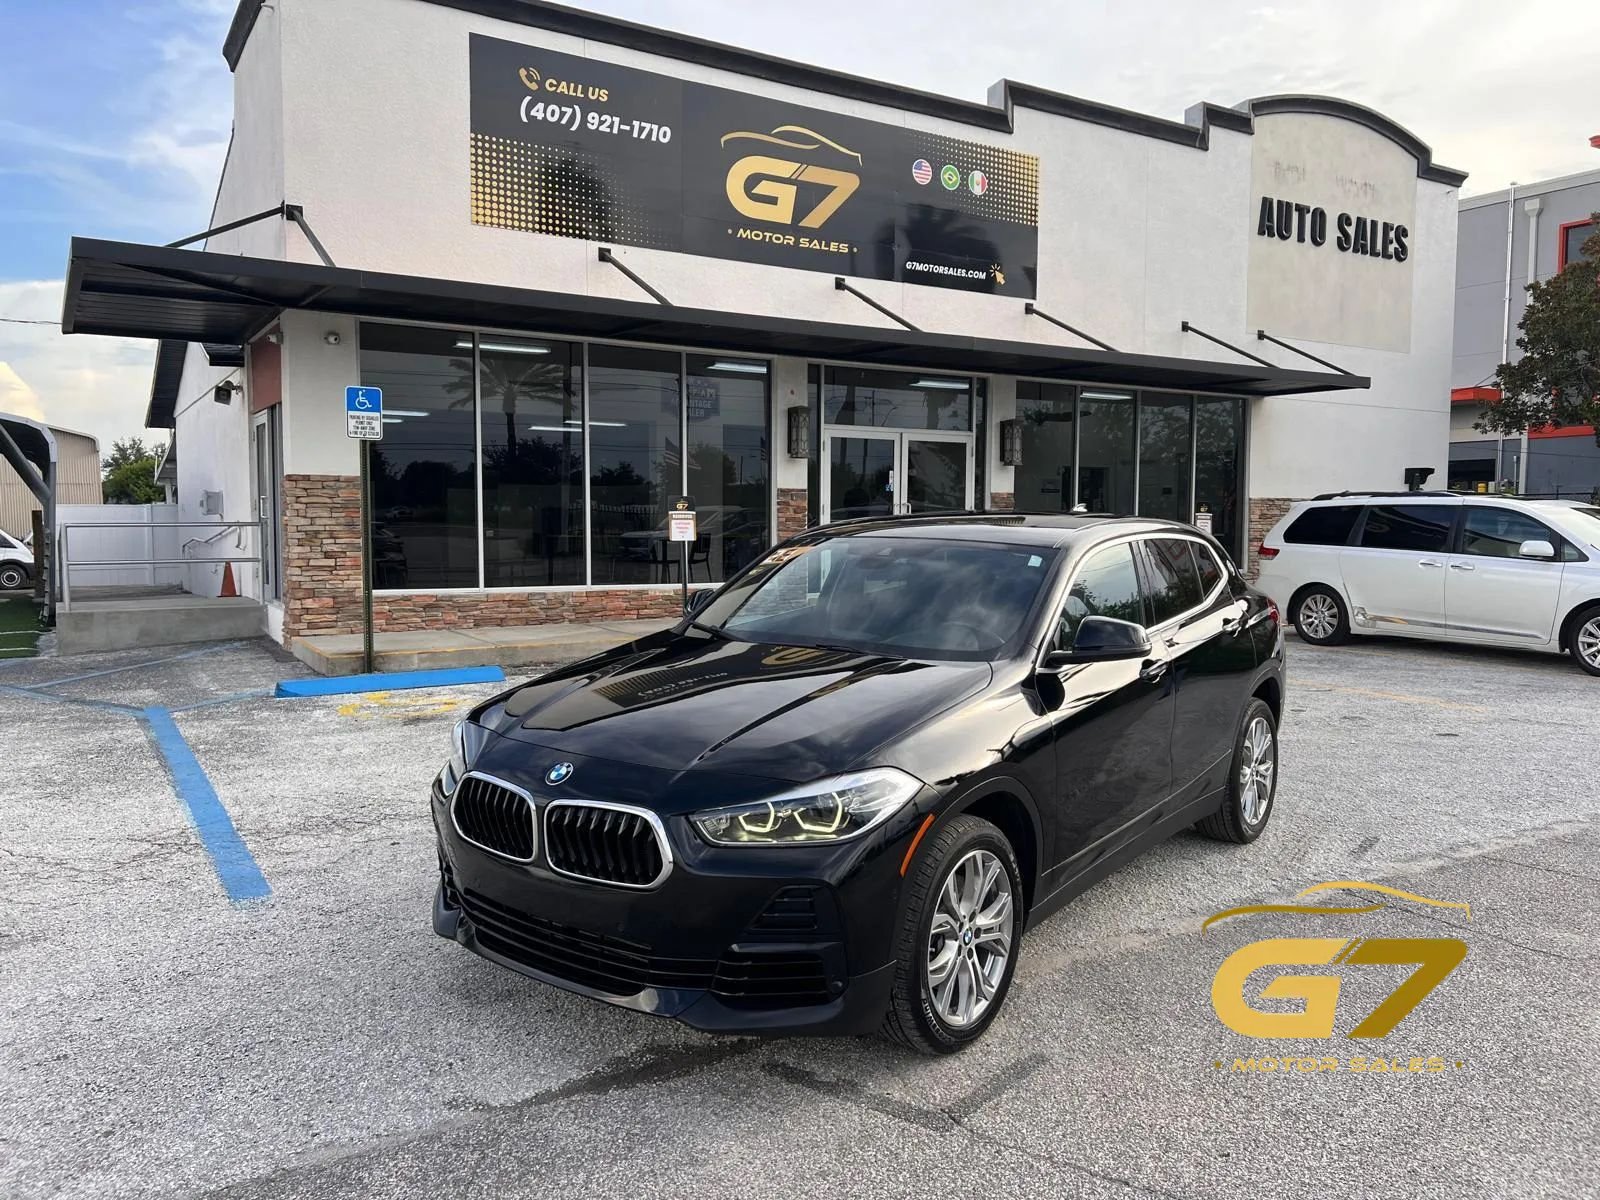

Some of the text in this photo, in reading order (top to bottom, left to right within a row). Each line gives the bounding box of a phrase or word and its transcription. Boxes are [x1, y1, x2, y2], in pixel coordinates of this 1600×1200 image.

[545, 78, 609, 102] CALL US
[520, 95, 672, 144] (407) 921-1710
[725, 155, 861, 229] G7
[737, 227, 849, 254] MOTOR SALES
[1257, 196, 1409, 263] AUTO SALES
[905, 260, 987, 280] G7MOTORSALES.COM
